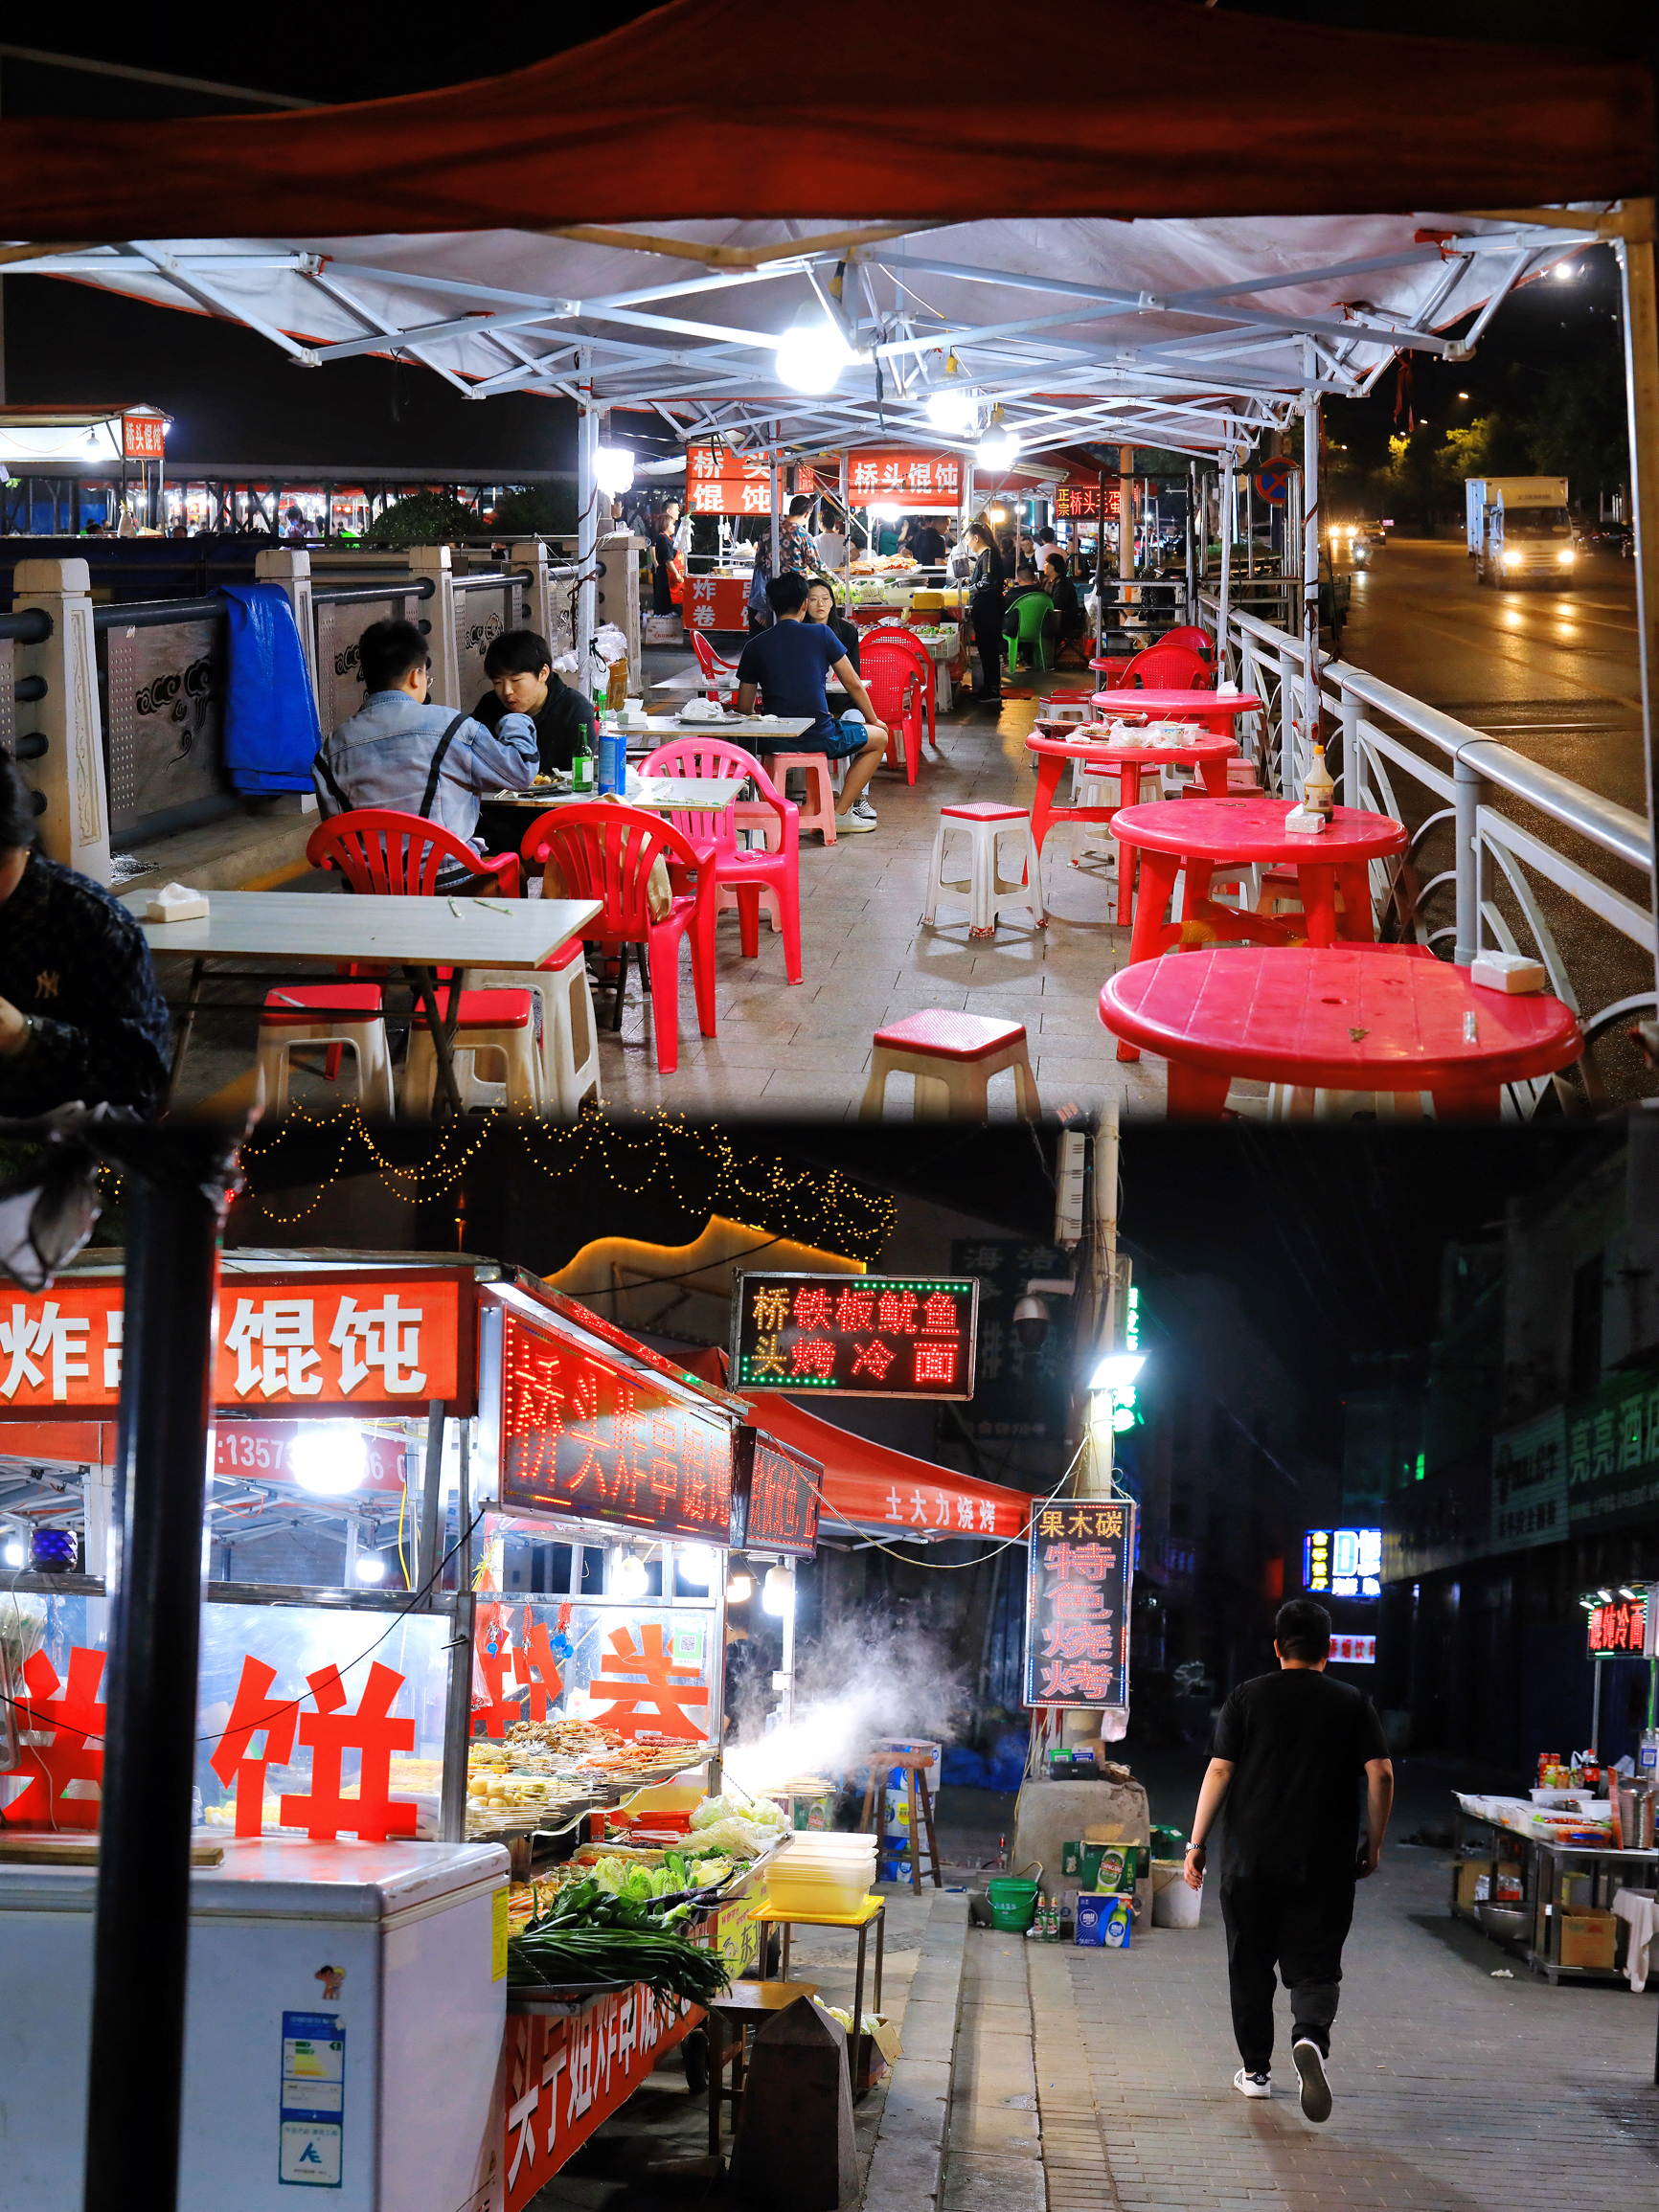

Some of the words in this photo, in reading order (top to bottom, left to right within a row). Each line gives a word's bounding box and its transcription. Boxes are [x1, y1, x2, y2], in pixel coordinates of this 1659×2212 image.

[125, 421, 162, 451] 桥头馄饨
[693, 450, 772, 479] 桥头
[853, 462, 959, 495] 桥头馄饨
[692, 484, 772, 512] 馄饨
[1057, 488, 1070, 516] 正宗
[751, 1285, 791, 1377] 桥头
[791, 1286, 961, 1337] 铁板鱿鱼
[0, 1293, 427, 1402] 炸馄饨
[789, 1336, 960, 1385] 烤冷面
[884, 1485, 996, 1534] 土大力烧烤
[1038, 1509, 1124, 1540] 果木碳
[1039, 1541, 1117, 1701] 特色烧烤
